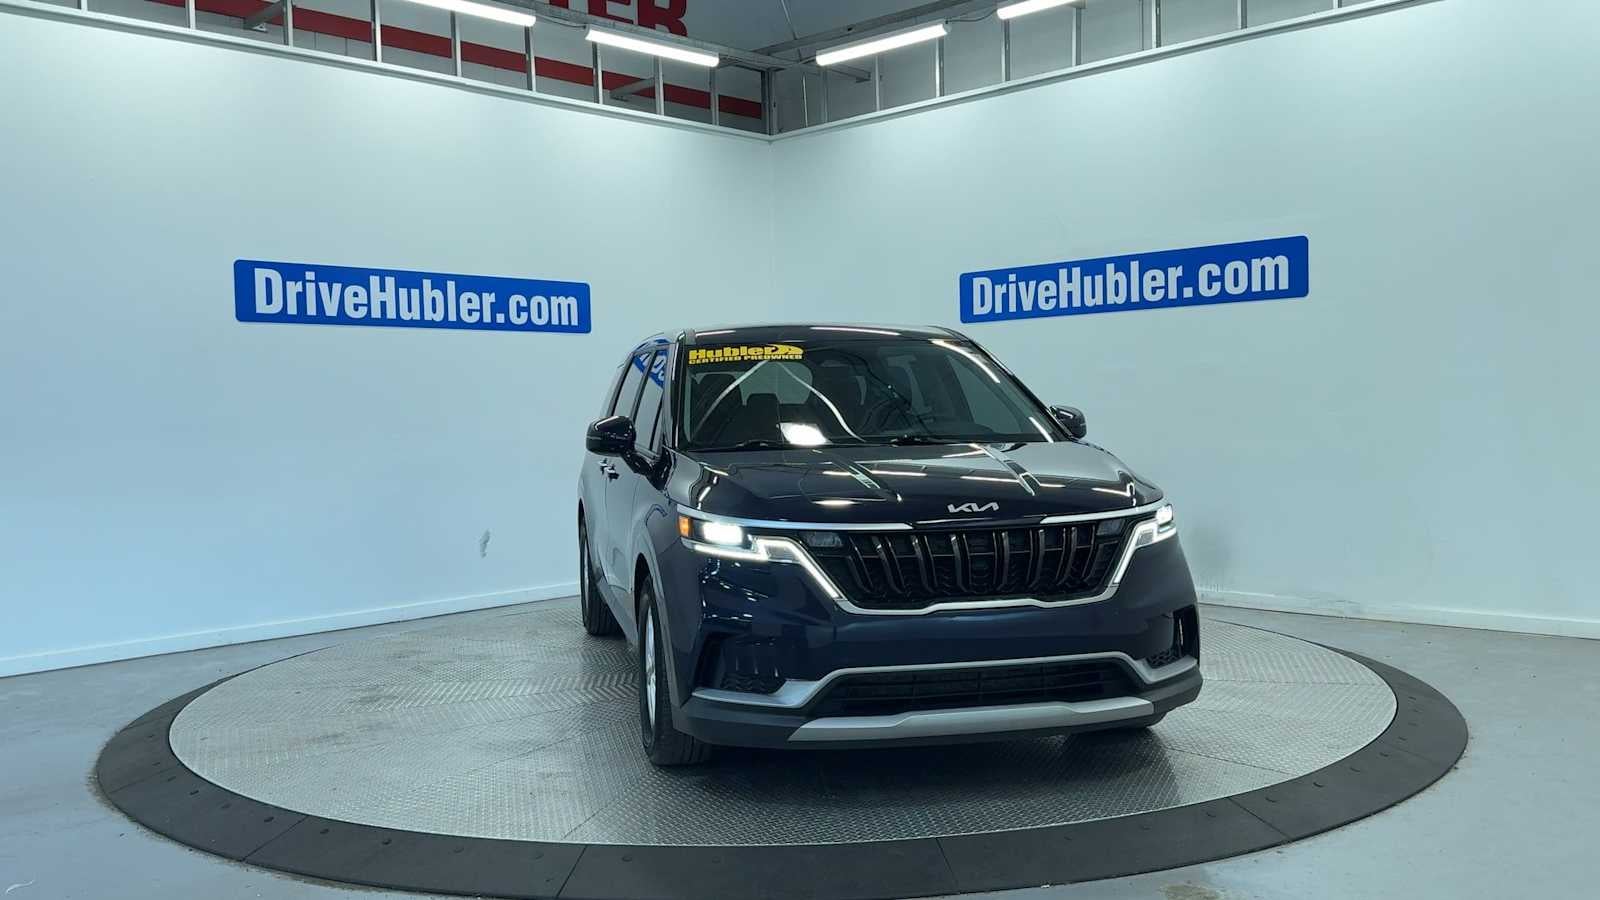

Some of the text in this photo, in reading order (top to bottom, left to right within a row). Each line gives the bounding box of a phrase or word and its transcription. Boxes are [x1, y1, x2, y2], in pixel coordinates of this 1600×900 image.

[972, 254, 1289, 315] DriveHubler.com
[253, 267, 579, 326] DriveHubler.com
[688, 344, 778, 360] Hubler
[688, 356, 742, 365] CERTIFIED
[947, 502, 999, 513] KIA
